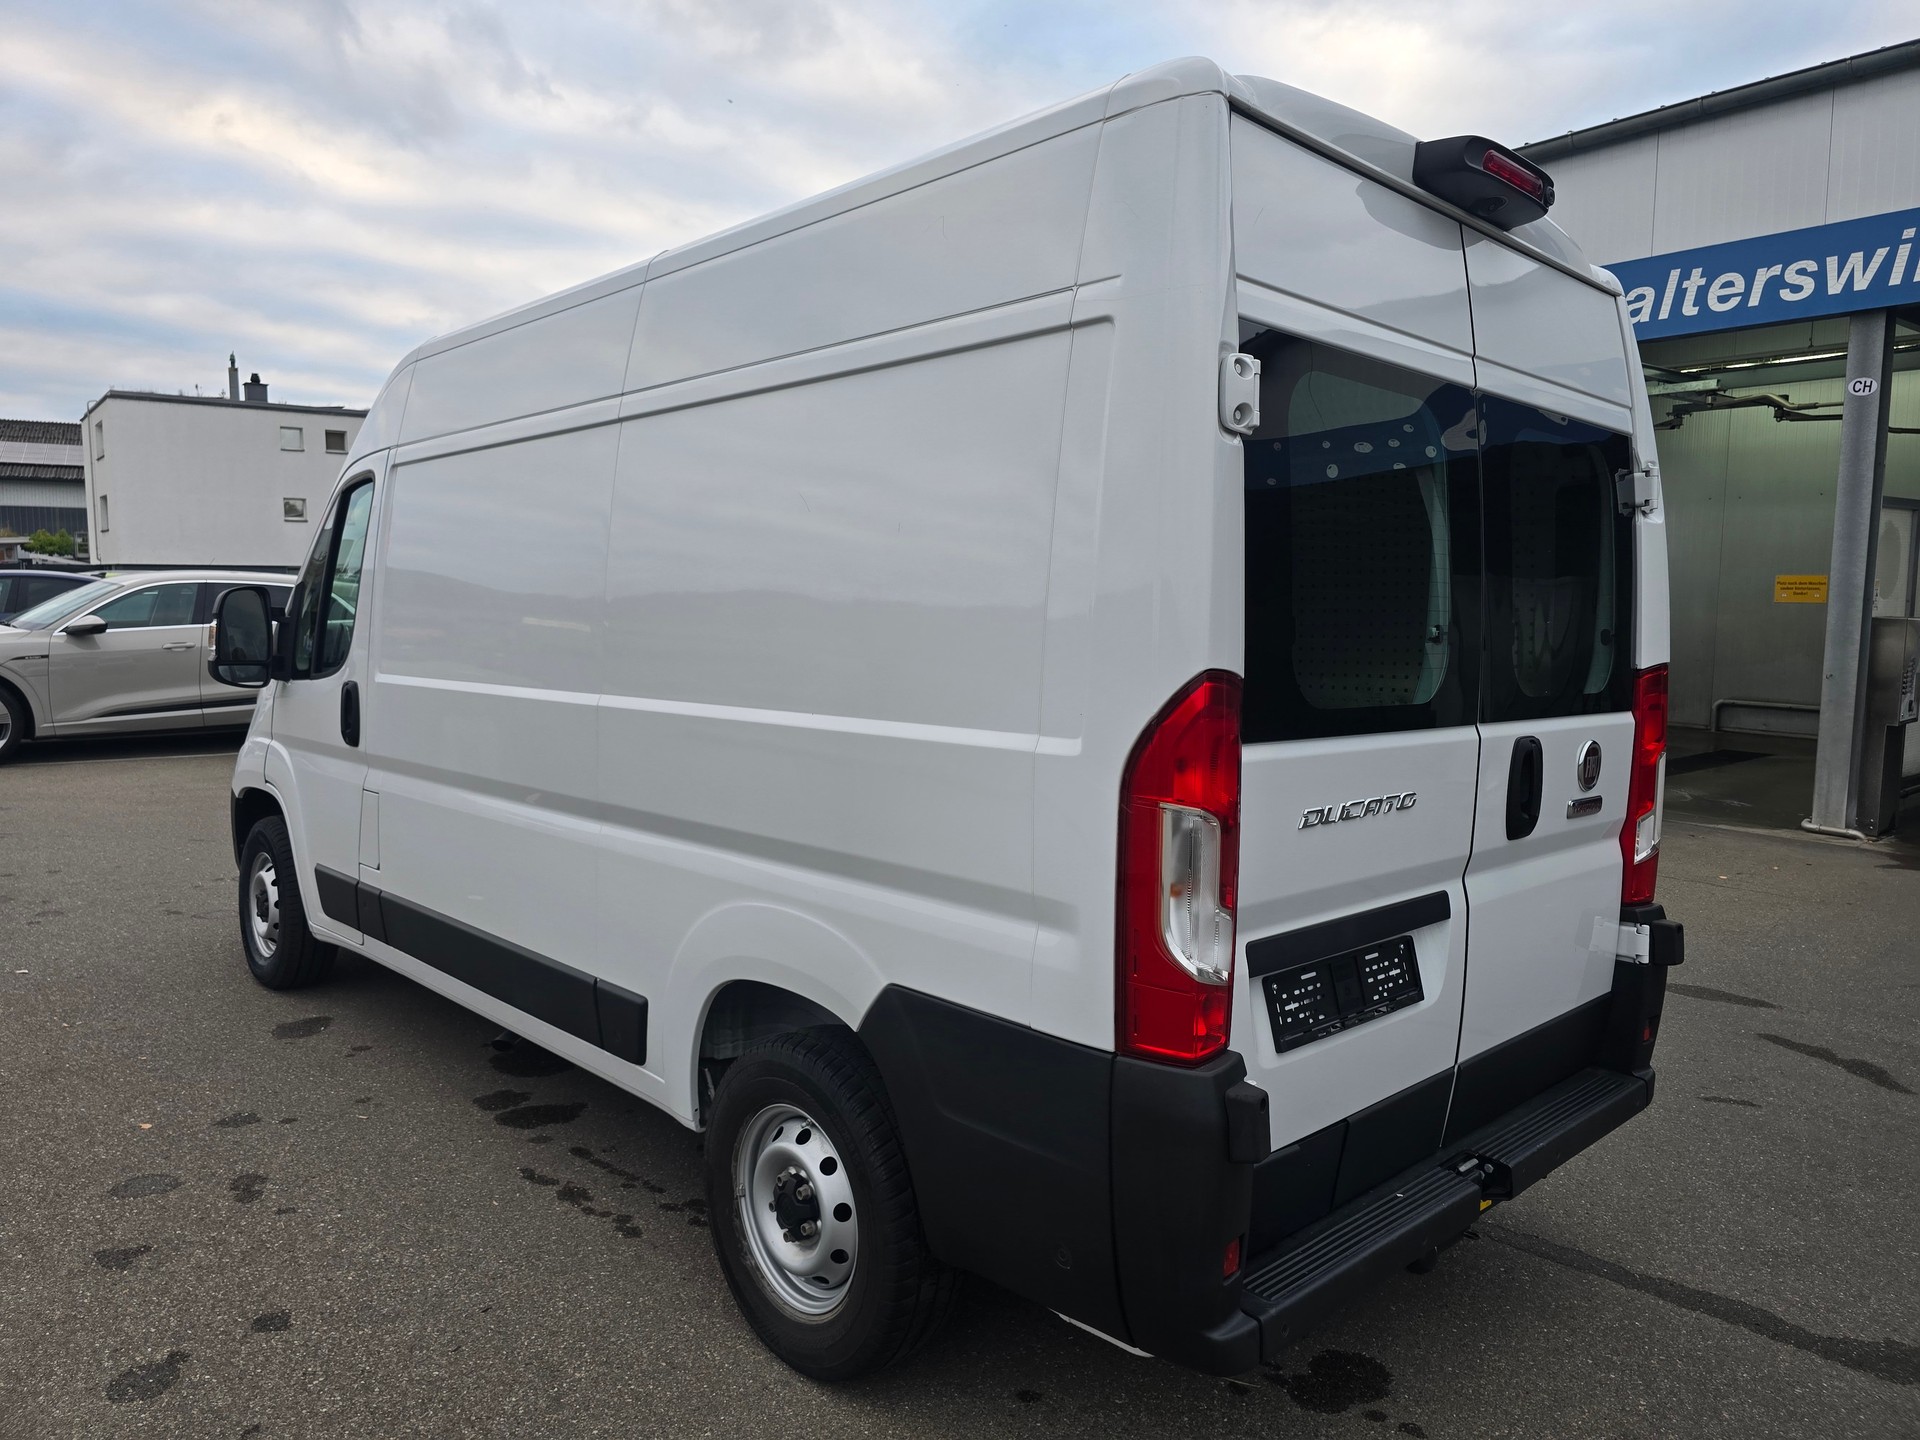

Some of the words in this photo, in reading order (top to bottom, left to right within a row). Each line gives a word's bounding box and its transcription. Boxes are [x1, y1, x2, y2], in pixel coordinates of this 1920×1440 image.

[1626, 227, 1920, 325] alterswi
[1852, 380, 1873, 393] CH
[1298, 791, 1417, 830] DUCATO
